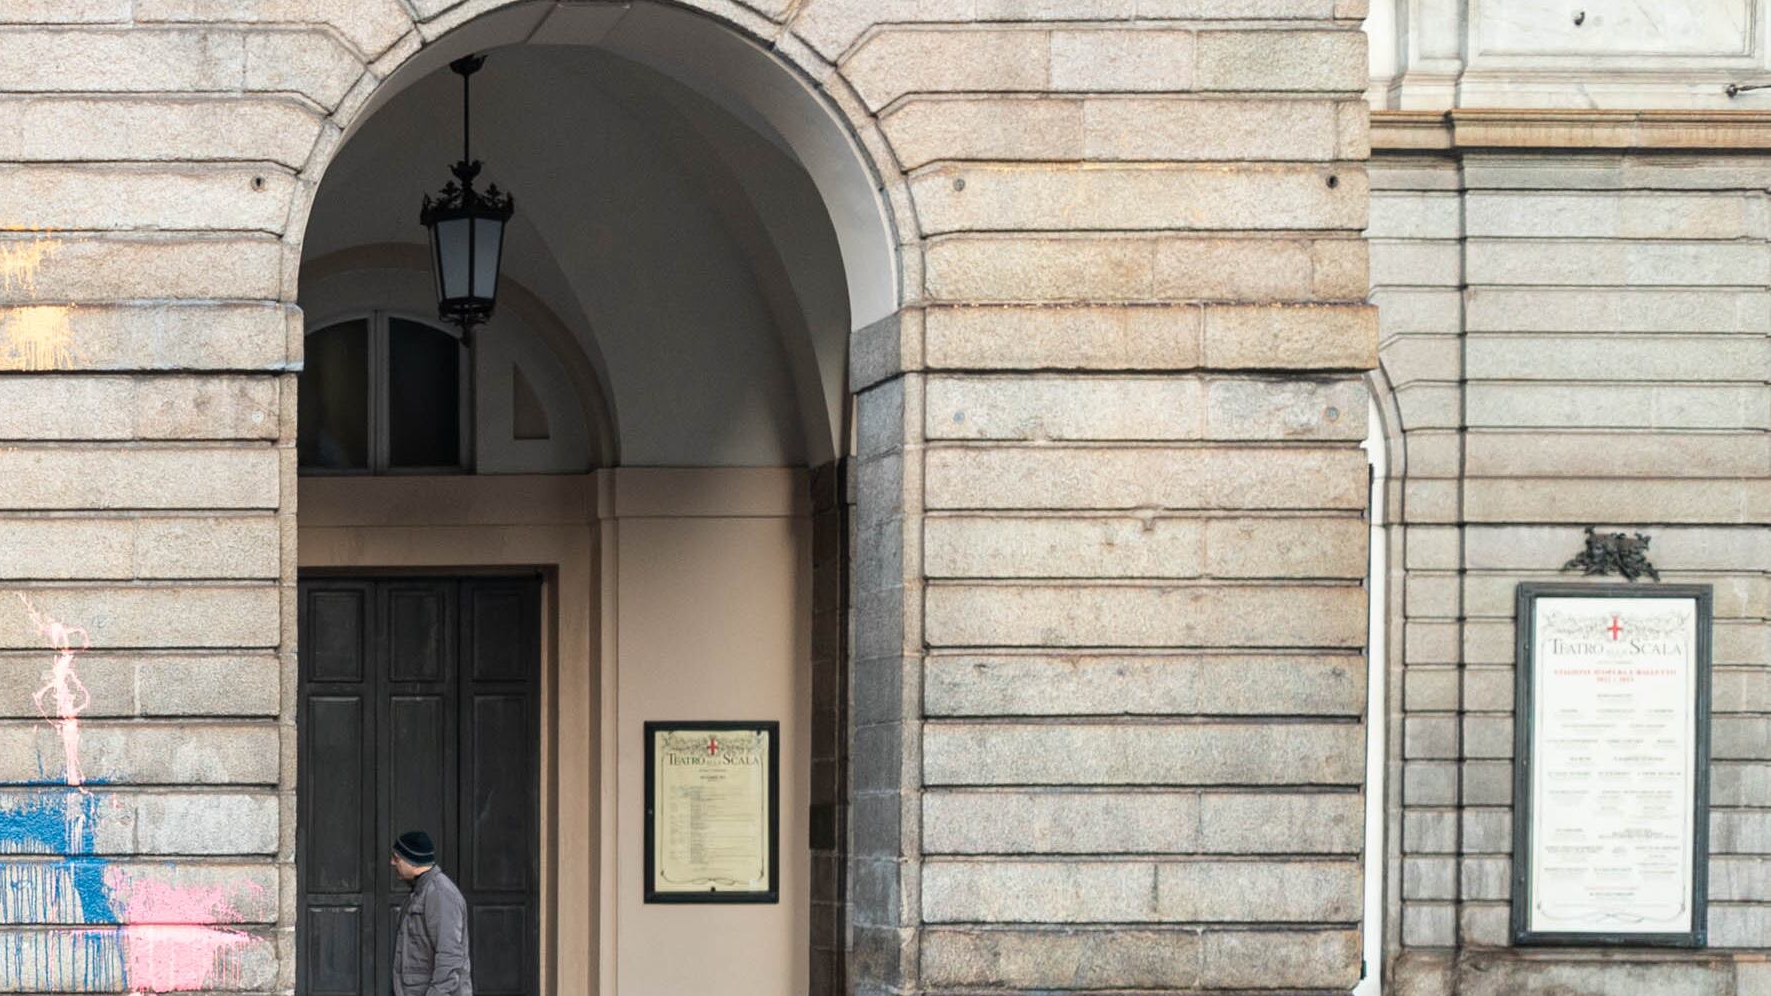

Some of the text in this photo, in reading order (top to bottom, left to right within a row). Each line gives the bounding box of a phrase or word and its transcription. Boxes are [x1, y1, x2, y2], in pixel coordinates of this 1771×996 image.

[1553, 638, 1604, 655] TEATRO
[1629, 639, 1682, 656] SCALA
[668, 752, 706, 766] TEATRO
[723, 753, 760, 766] SCALA
